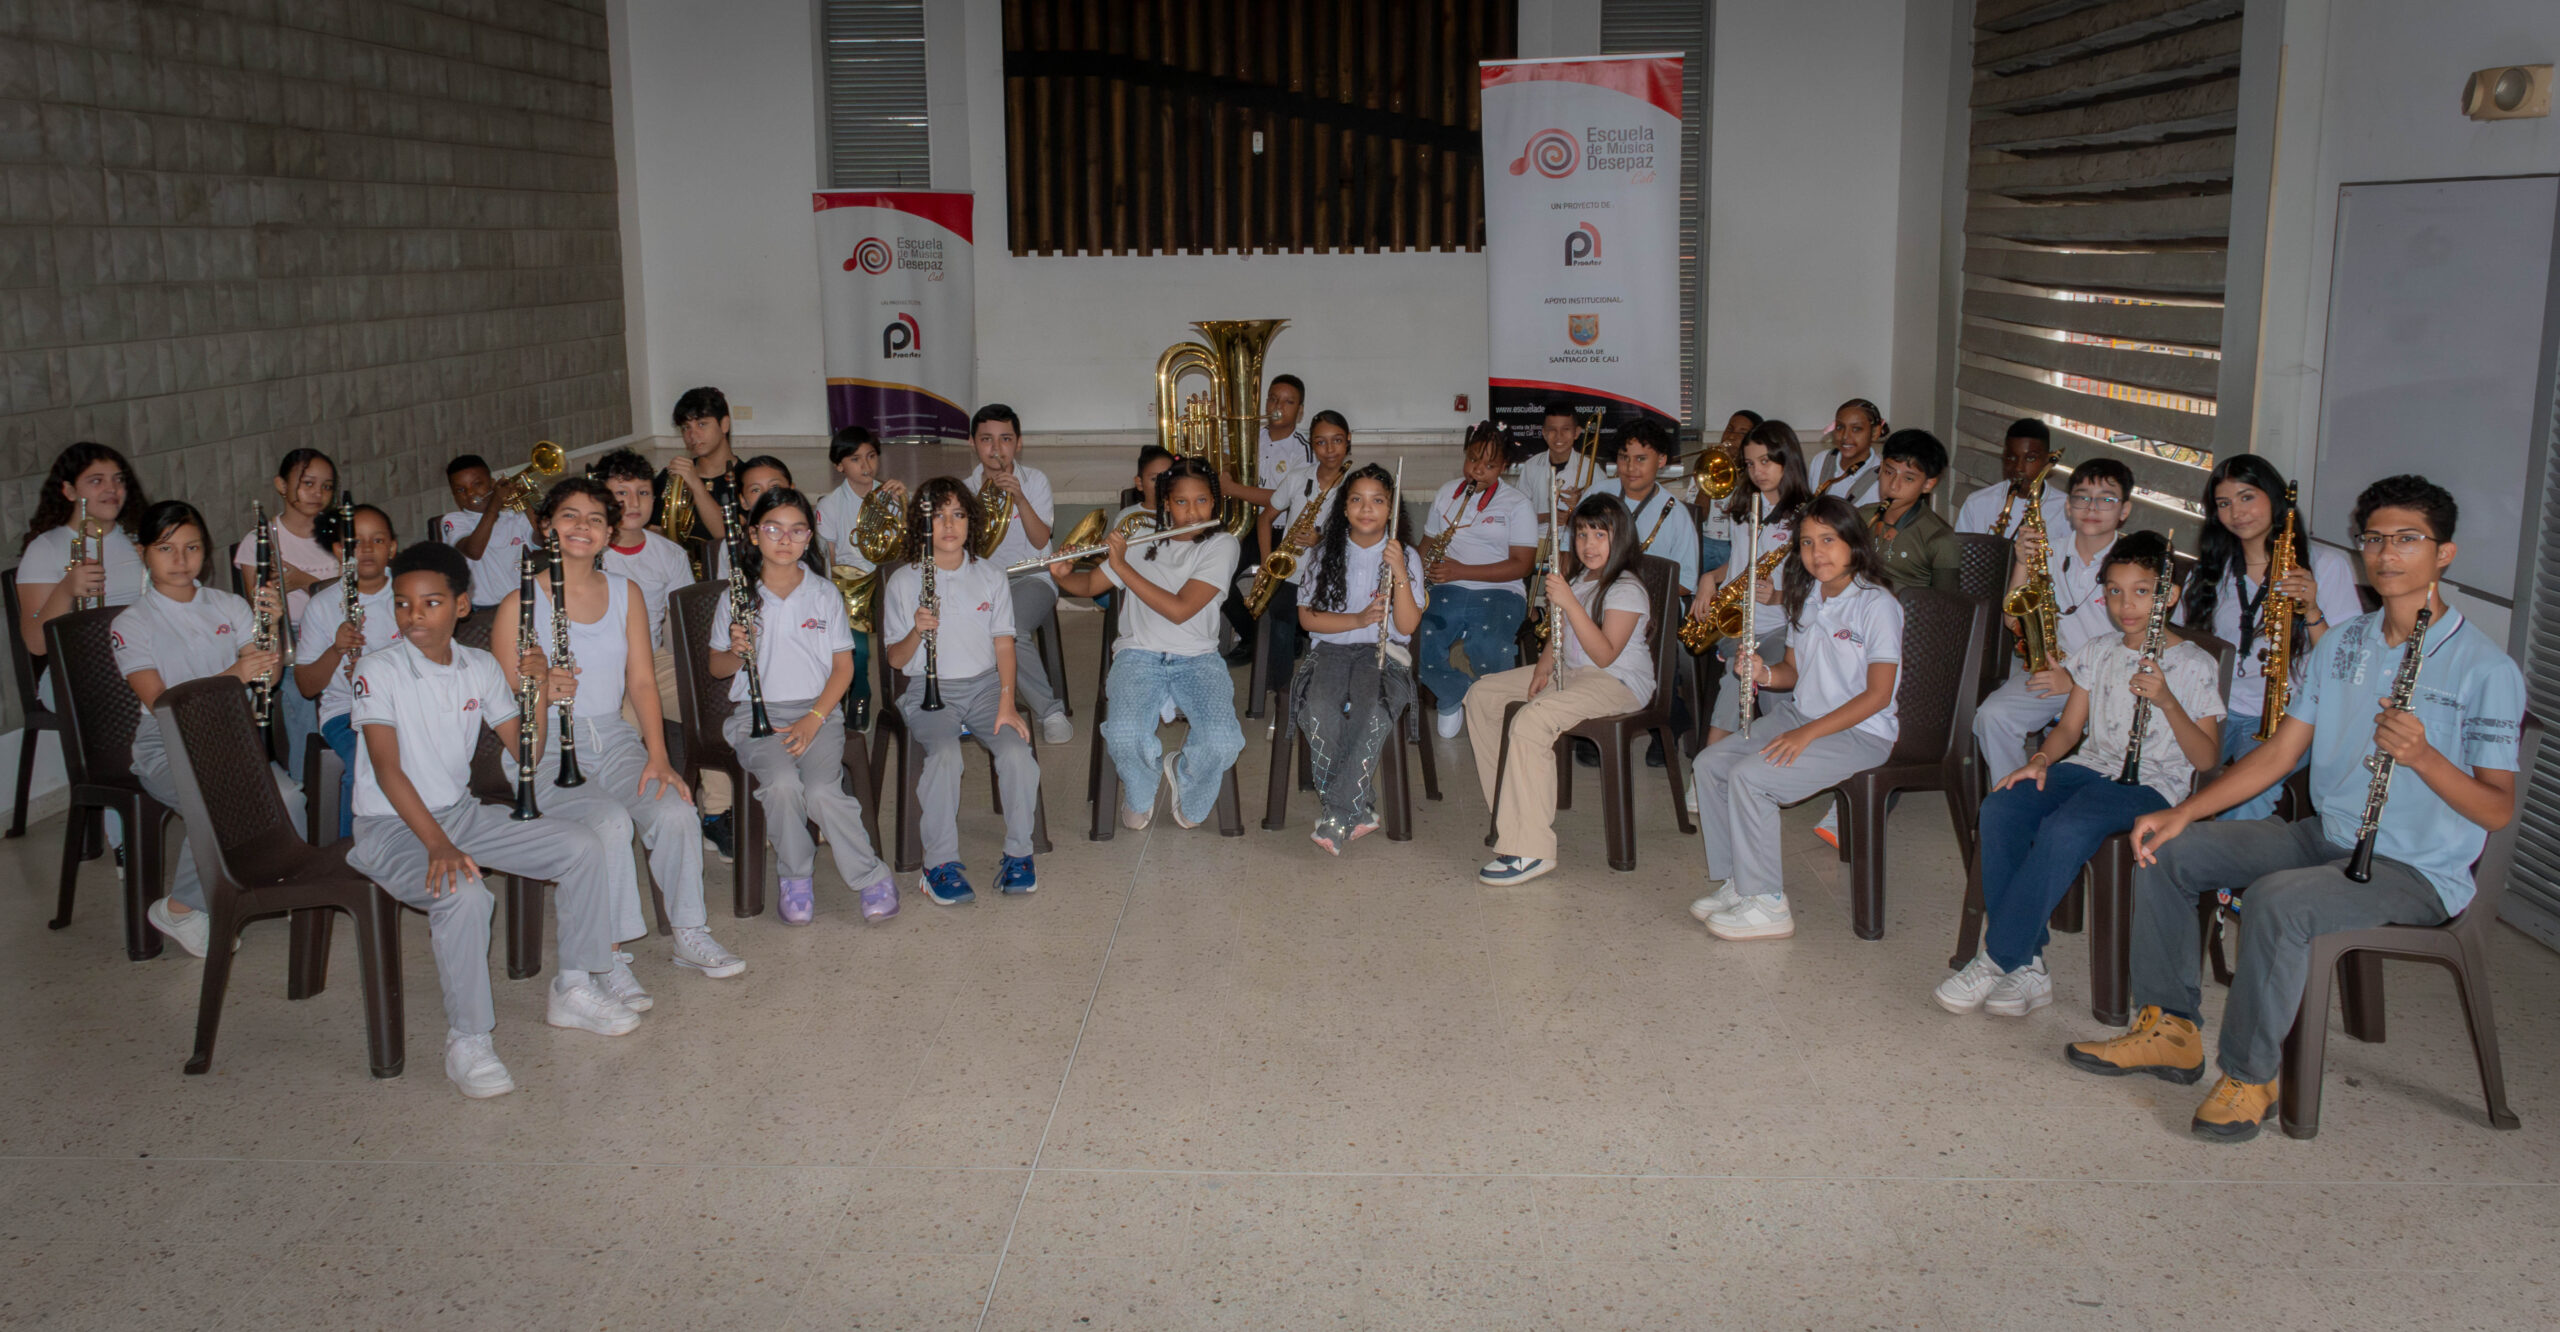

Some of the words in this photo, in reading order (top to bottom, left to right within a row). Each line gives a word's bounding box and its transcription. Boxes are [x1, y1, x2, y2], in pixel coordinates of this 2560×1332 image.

[1586, 125, 1655, 143] Escuela
[1586, 143, 1603, 155] de
[1607, 141, 1654, 155] Música
[1587, 155, 1654, 173] Desepaz
[1550, 202, 1562, 210] UN
[1563, 202, 1600, 210] PROYECTO
[897, 236, 943, 250] Escuela
[897, 257, 943, 273] Desepaz
[1544, 297, 1567, 305] APOYO
